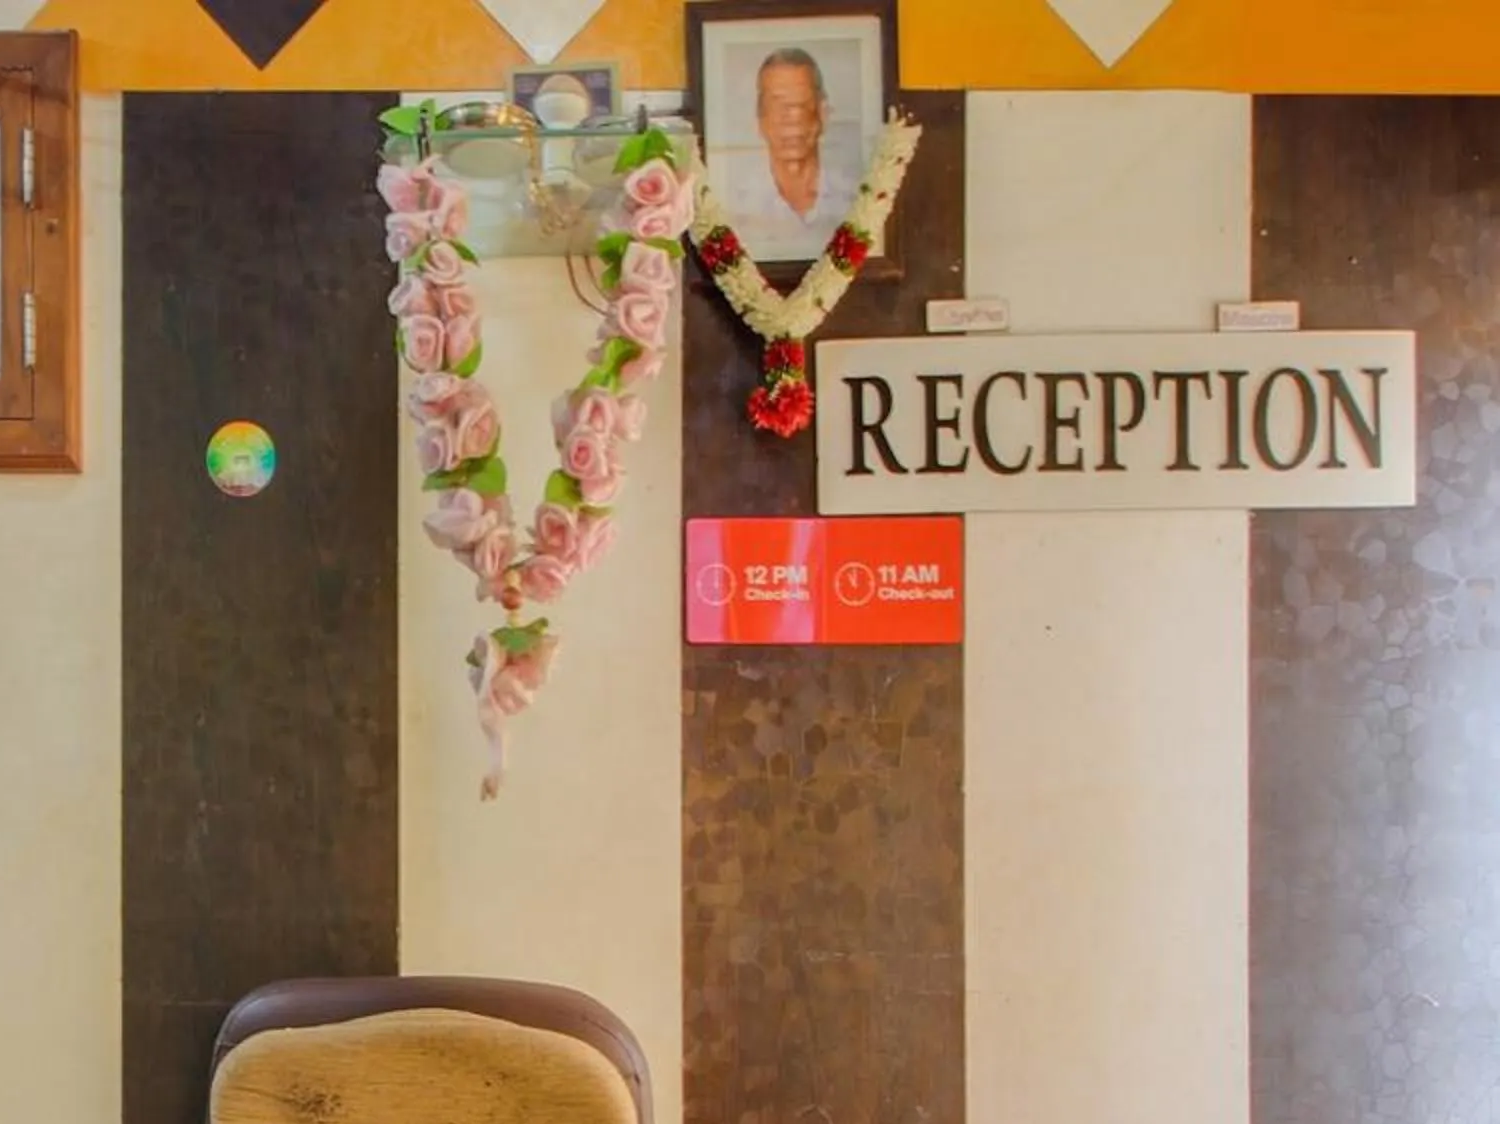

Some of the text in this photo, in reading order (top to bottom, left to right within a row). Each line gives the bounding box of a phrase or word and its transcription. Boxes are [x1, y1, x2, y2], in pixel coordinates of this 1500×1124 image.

[841, 367, 1388, 476] RECEPTION
[744, 566, 808, 584] 12 PM
[878, 564, 940, 584] 11 AM
[744, 586, 810, 601] Check-in
[877, 586, 955, 600] Check-out
